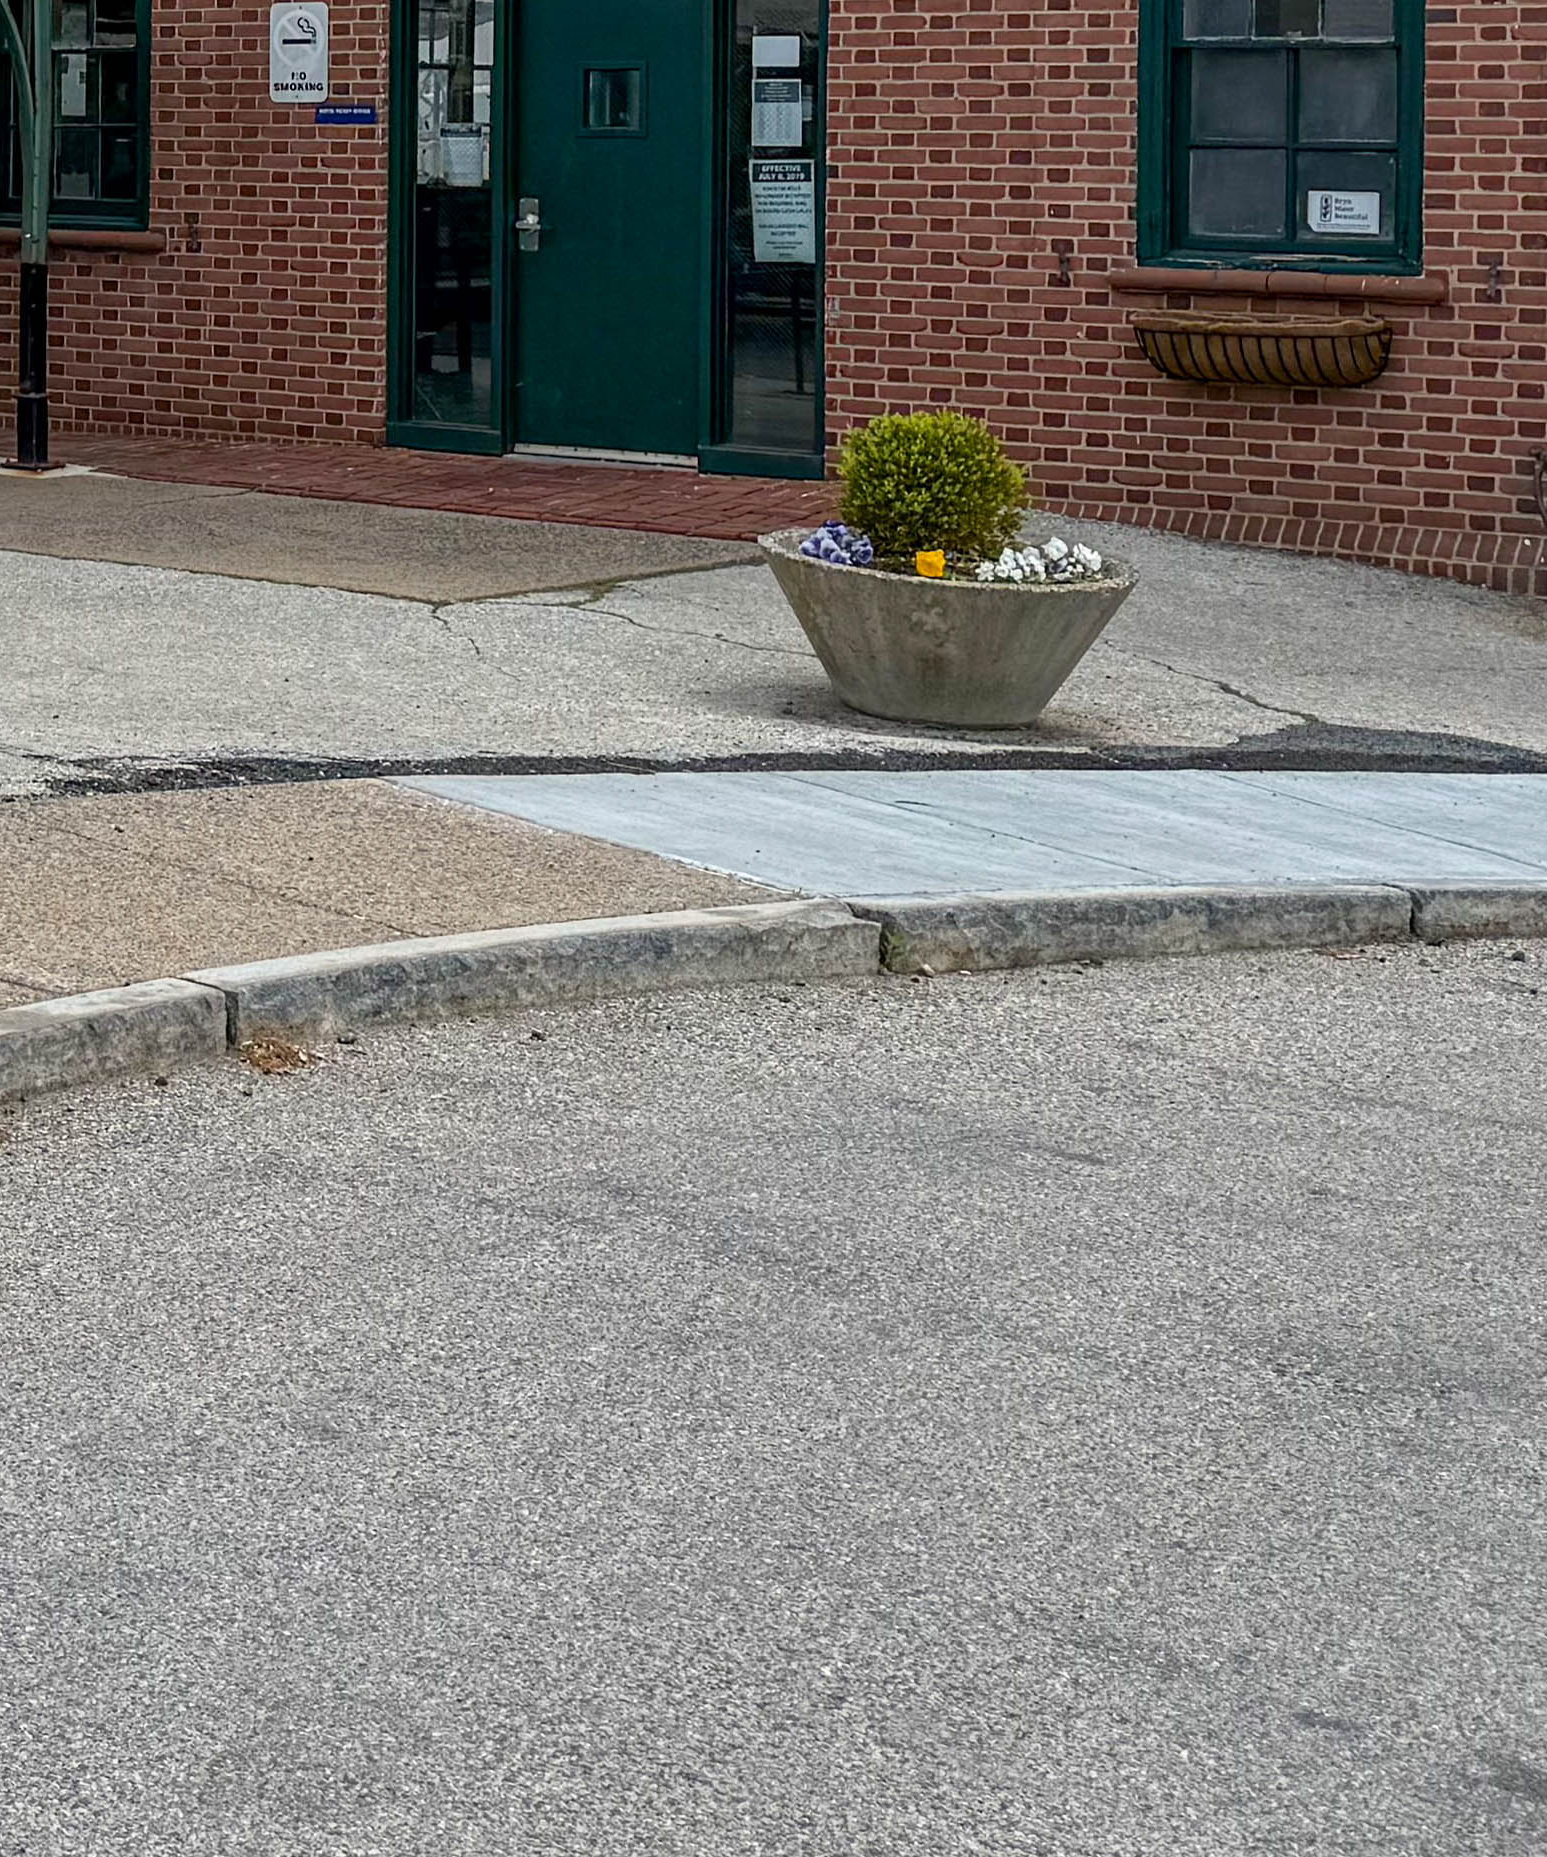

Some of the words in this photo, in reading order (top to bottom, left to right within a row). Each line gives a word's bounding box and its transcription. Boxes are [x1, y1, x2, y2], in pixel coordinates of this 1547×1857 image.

[291, 71, 307, 81] NO
[273, 82, 324, 92] SMOKING
[761, 165, 802, 173] EFFECTIVE
[758, 172, 776, 181] JULY
